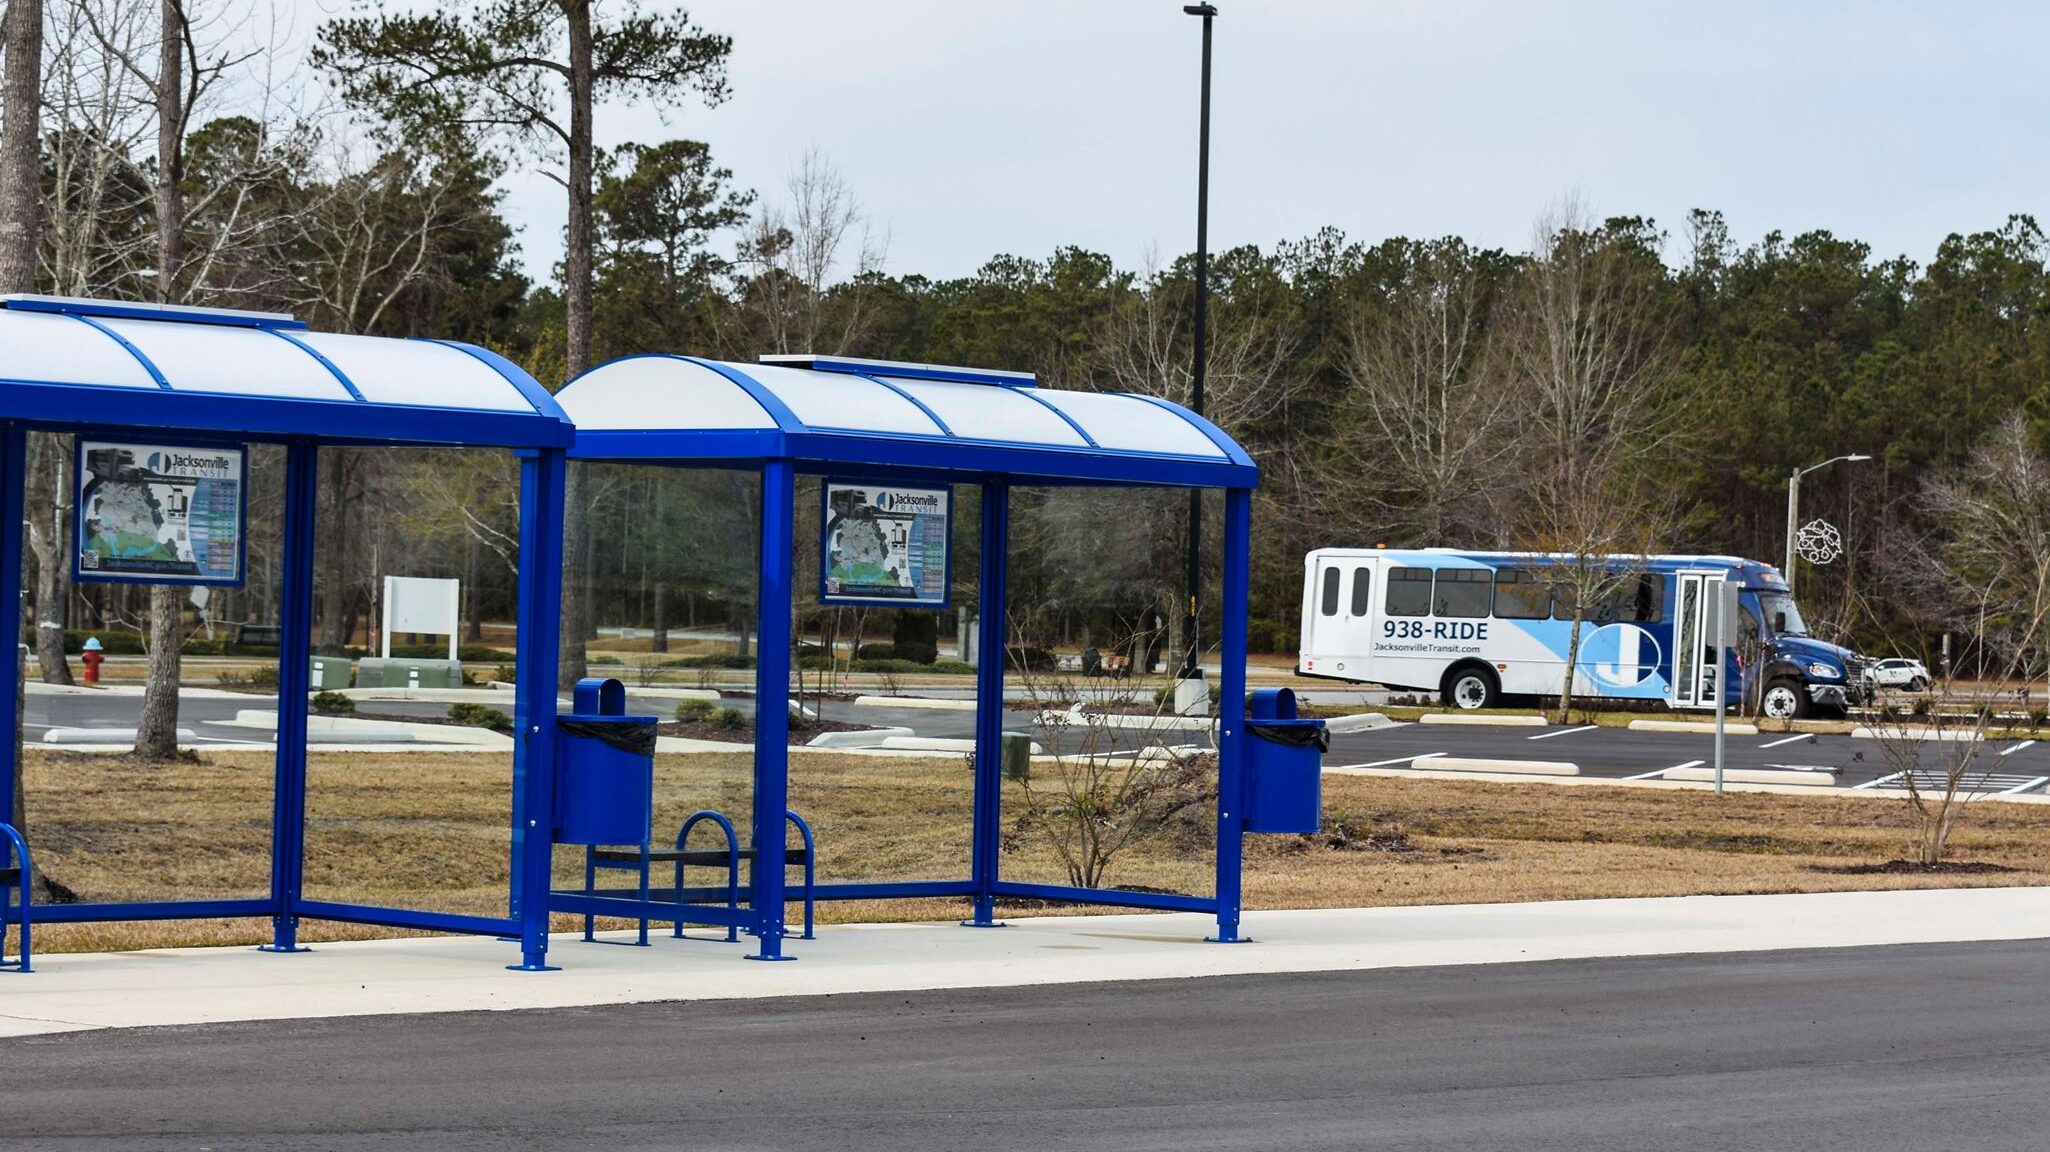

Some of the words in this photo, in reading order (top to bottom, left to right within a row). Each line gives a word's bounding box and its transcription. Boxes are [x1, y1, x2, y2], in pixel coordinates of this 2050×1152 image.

[172, 453, 229, 470] Jacksonville
[173, 467, 227, 479] TRANSIT
[894, 493, 938, 507] Jacksonville
[895, 504, 938, 514] TRANSIT
[1383, 620, 1488, 640] 938-RIDE
[1374, 642, 1481, 653] JacksonvilleTransit.com
